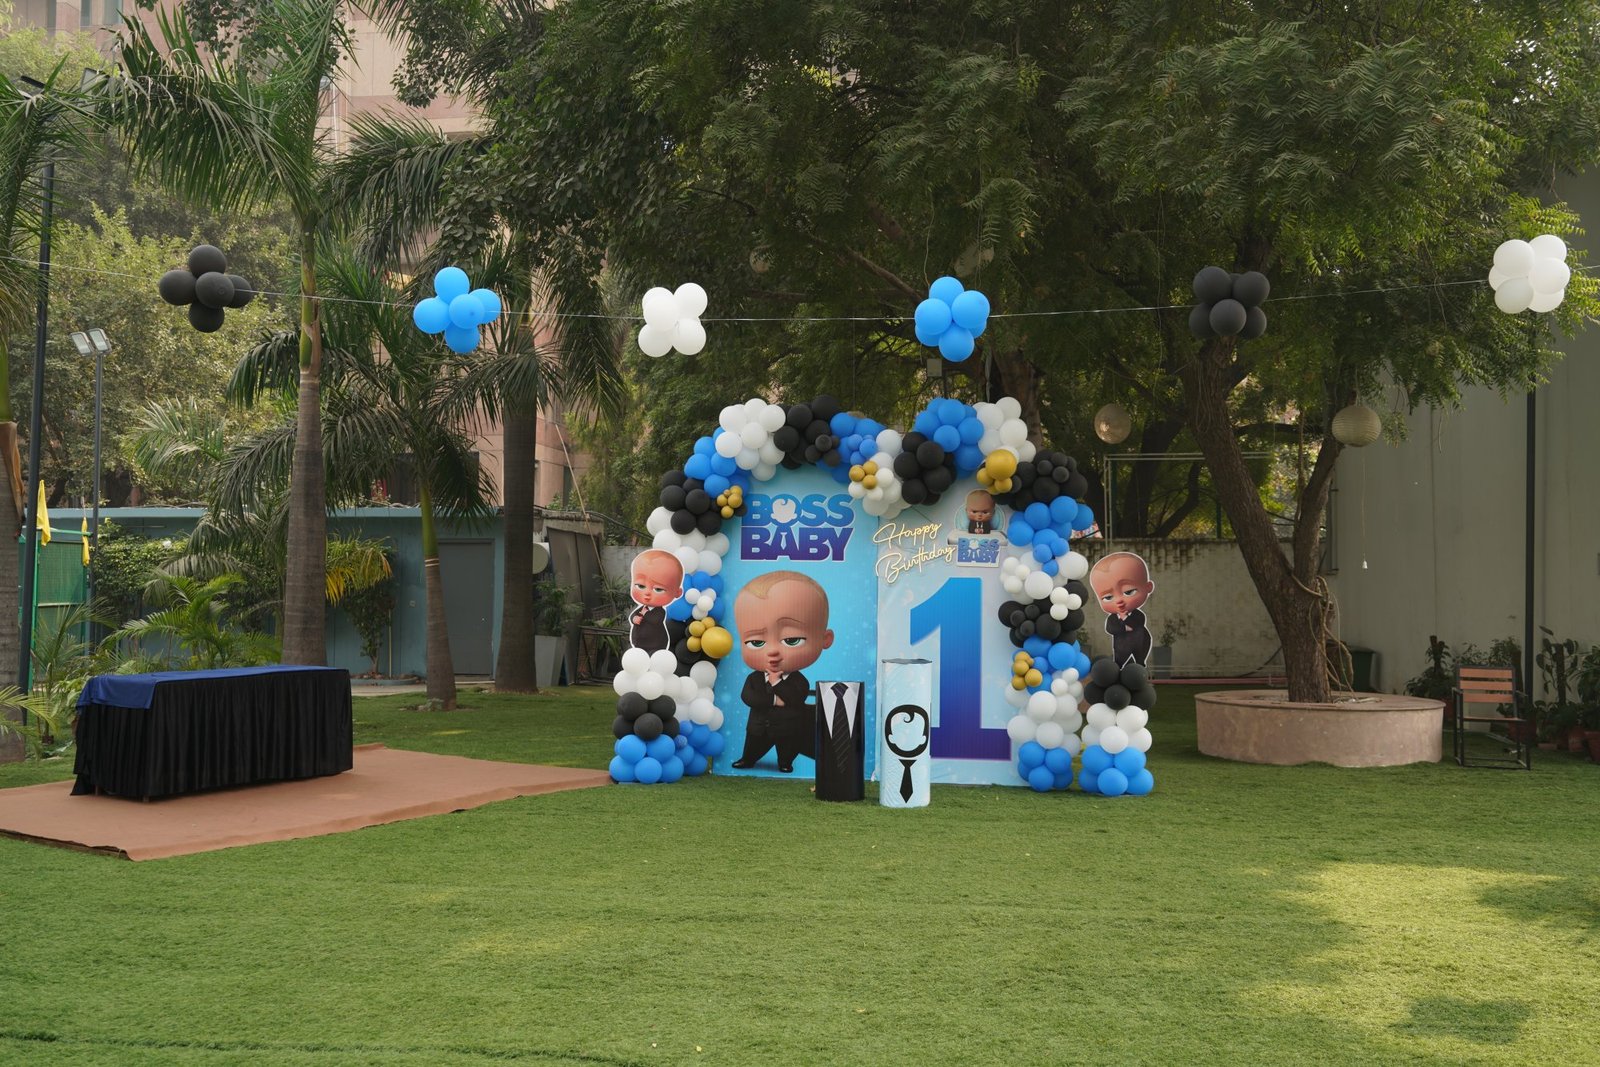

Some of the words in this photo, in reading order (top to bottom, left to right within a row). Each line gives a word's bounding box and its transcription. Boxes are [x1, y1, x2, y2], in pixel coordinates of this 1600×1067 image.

[741, 494, 854, 527] BOSS
[741, 527, 854, 561] BABY
[873, 523, 942, 549] Happy
[958, 538, 999, 550] BOSS
[876, 545, 956, 583] Birthday
[958, 549, 999, 563] BABY
[910, 577, 1011, 760] 1
